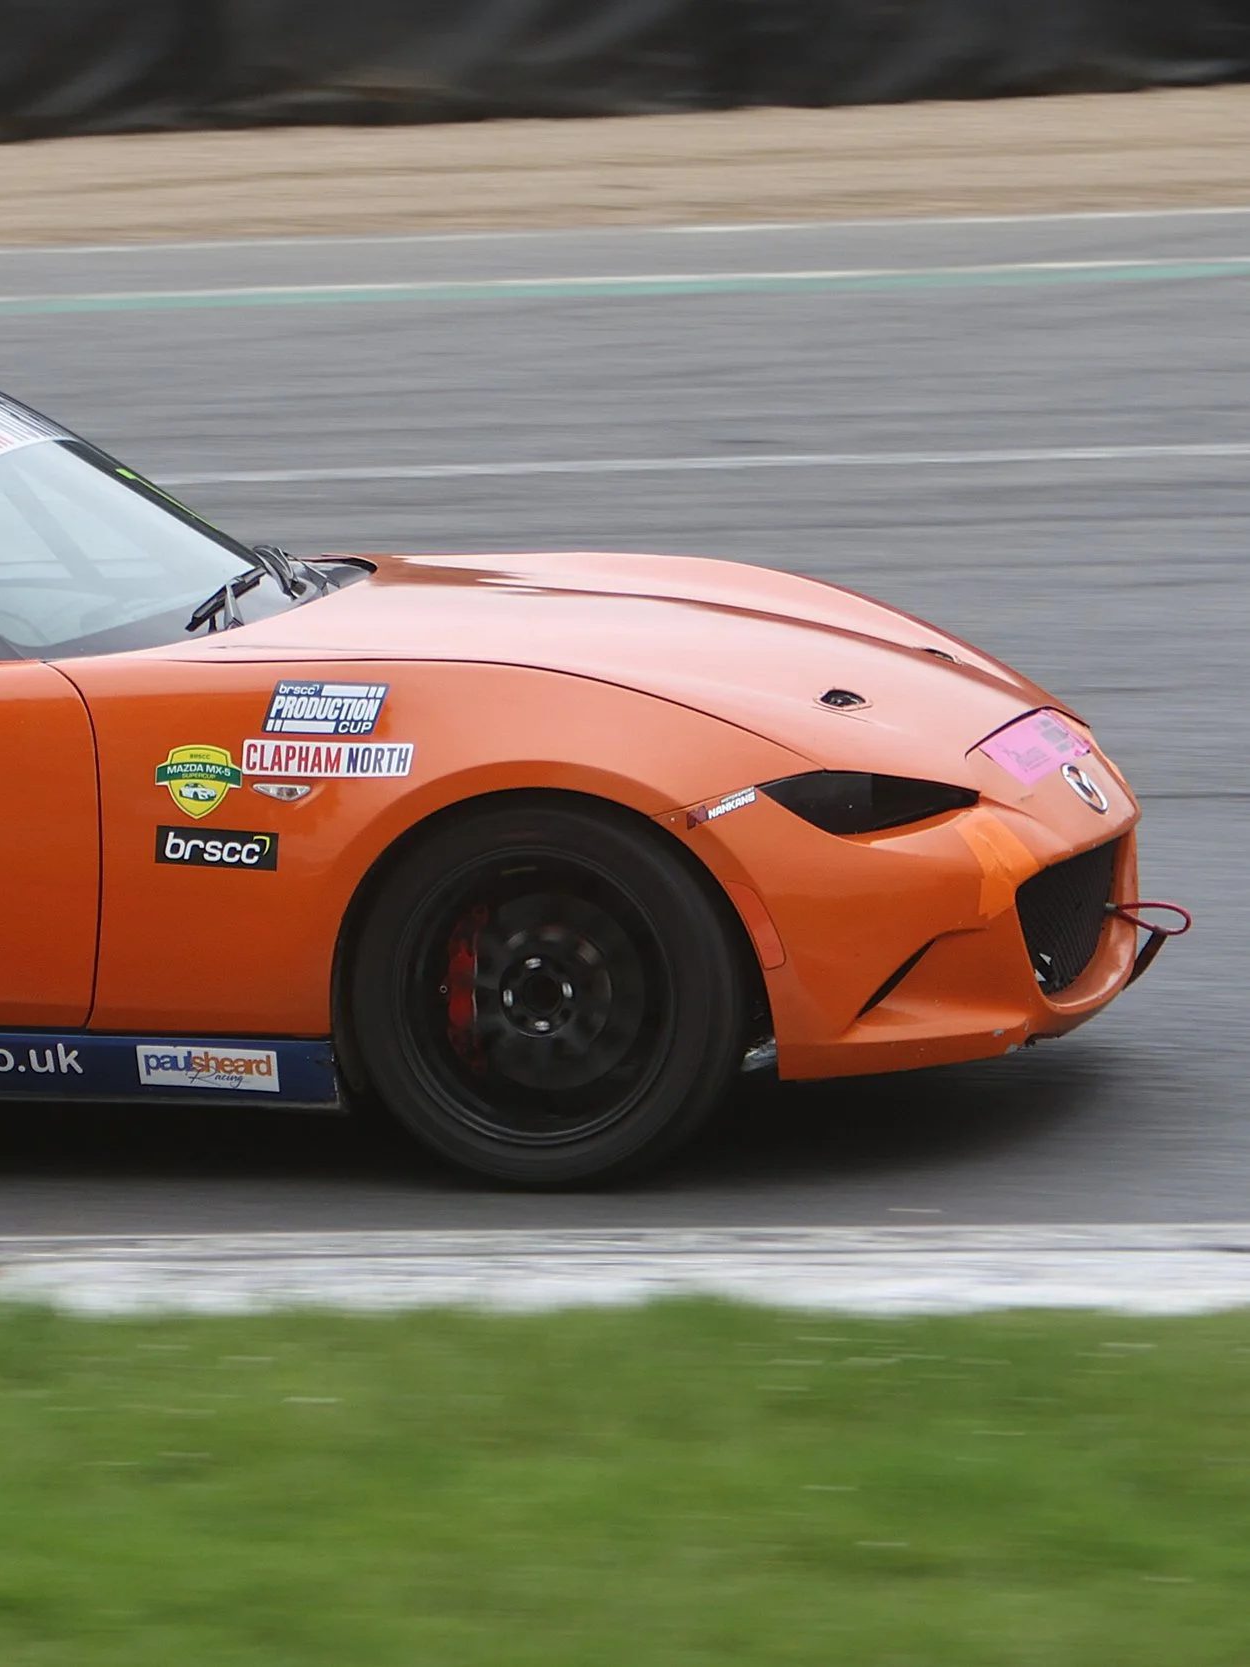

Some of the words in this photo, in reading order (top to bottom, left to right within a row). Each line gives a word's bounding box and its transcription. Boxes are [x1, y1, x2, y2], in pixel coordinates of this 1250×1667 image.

[278, 683, 315, 695] brscc
[269, 695, 381, 721] PRODUCTION
[338, 721, 372, 734] CUP
[166, 763, 204, 775] MAZDA
[205, 764, 231, 777] MX-5
[245, 743, 342, 773] CLAPHAM
[346, 747, 409, 774] NORTH
[707, 791, 756, 820] NANKANG
[165, 831, 261, 865] brscc
